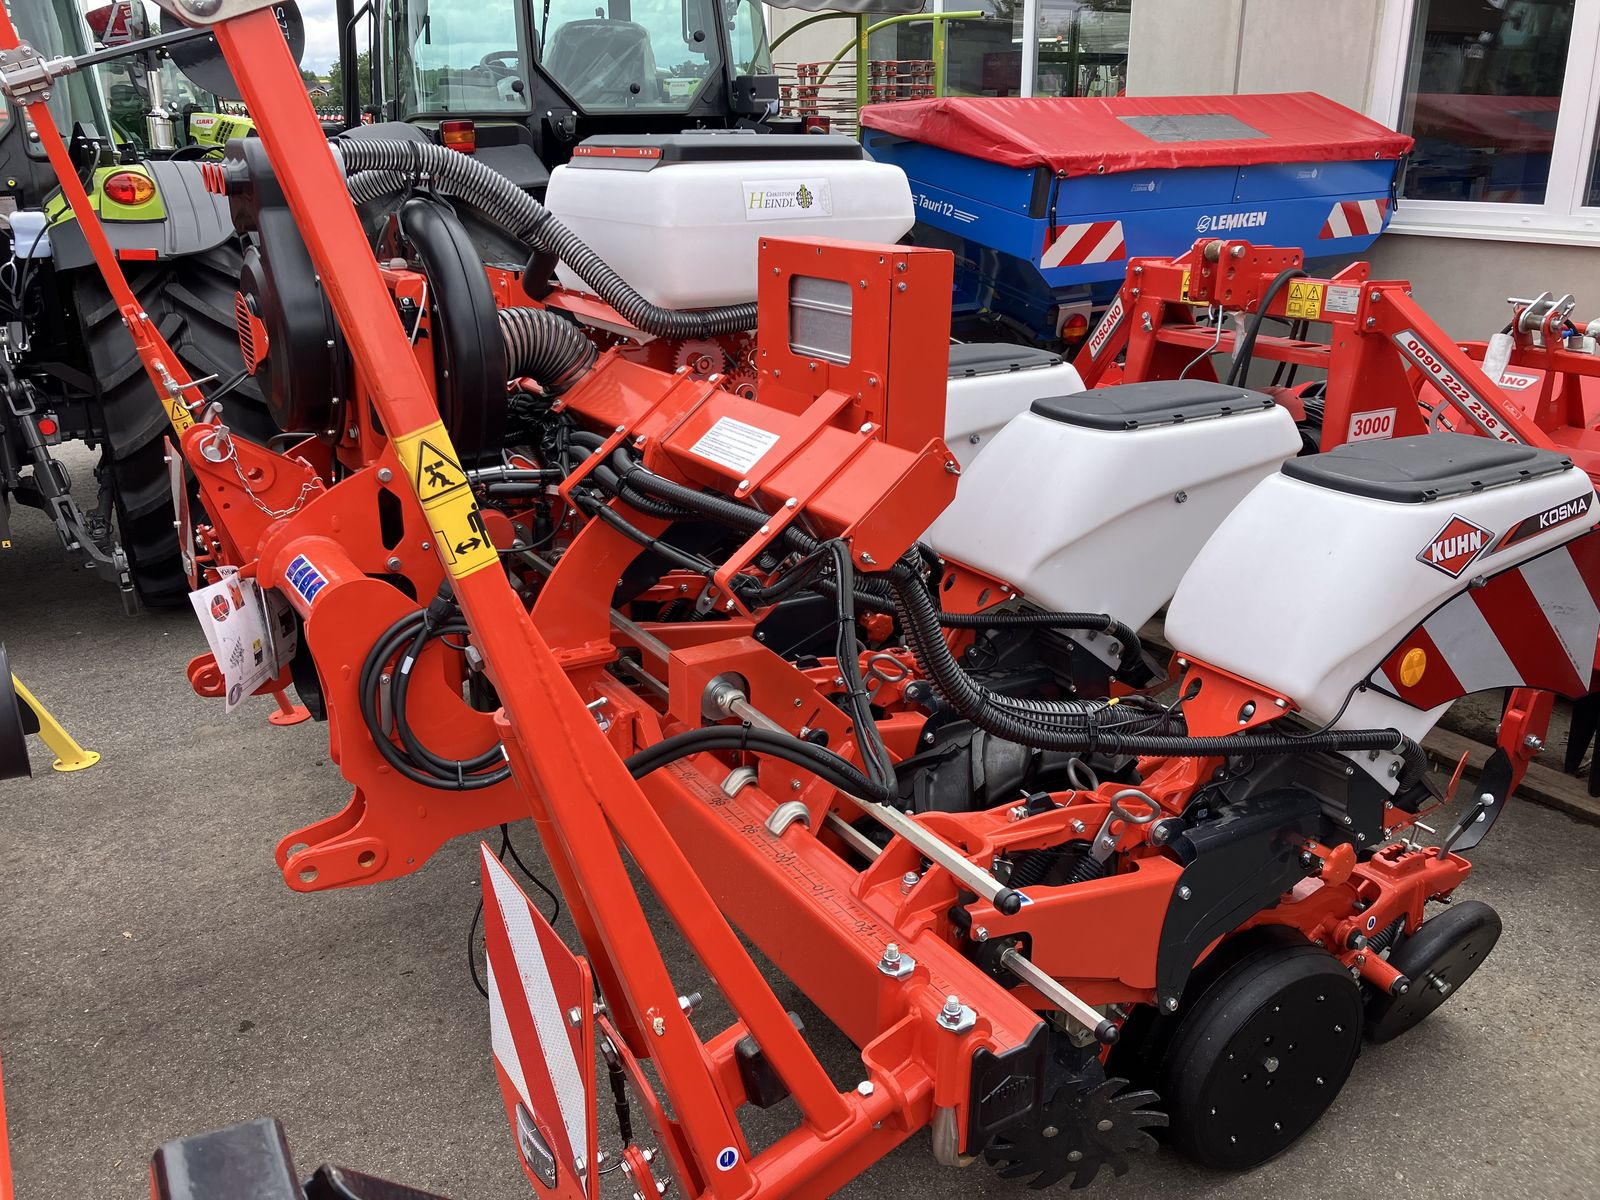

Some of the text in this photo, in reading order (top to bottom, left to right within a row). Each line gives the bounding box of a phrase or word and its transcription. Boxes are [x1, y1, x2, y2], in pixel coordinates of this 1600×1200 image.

[748, 191, 796, 209] HEINDL
[919, 194, 954, 217] Tauri 12
[1210, 211, 1267, 232] LEMKEN
[1090, 304, 1122, 351] TOSCANO
[1407, 340, 1442, 374] 0090
[1441, 374, 1470, 402] 222
[1469, 402, 1498, 429] 236
[1353, 415, 1390, 437] 3000
[1540, 498, 1588, 529] KOSMA
[1431, 530, 1482, 563] KUHN
